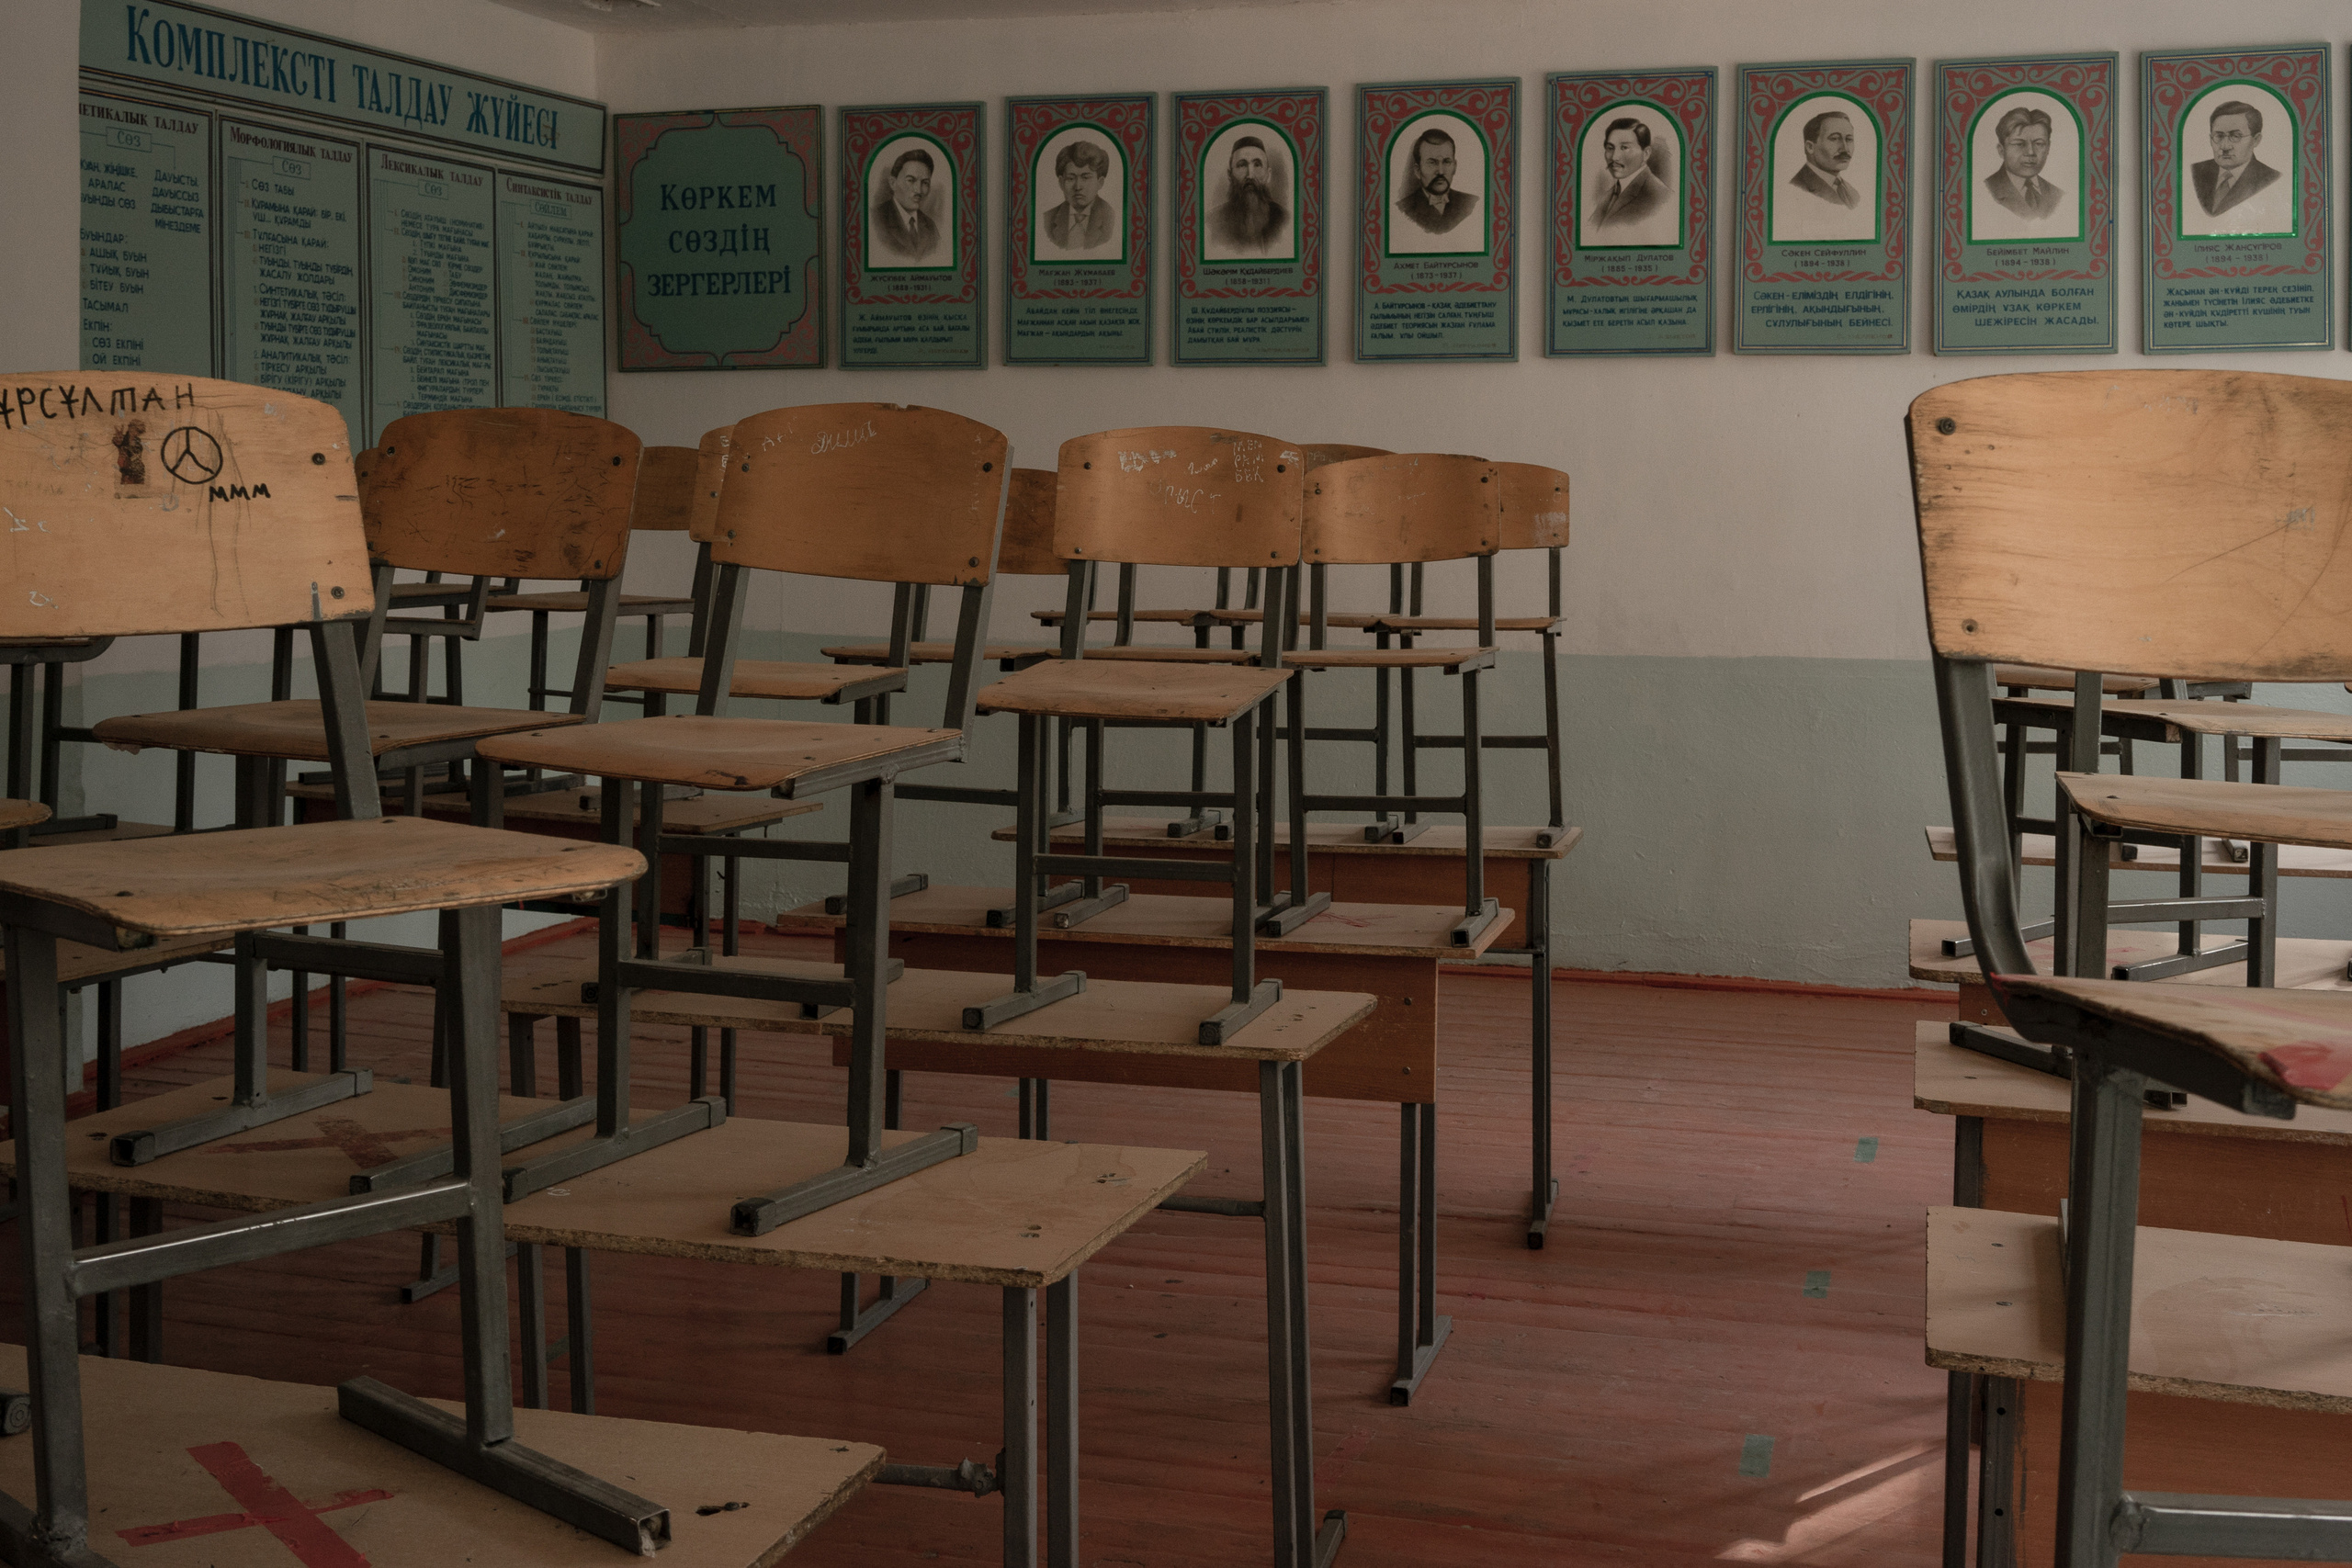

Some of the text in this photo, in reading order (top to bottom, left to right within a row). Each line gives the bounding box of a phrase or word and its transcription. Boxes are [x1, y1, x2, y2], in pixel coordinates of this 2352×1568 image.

[126, 4, 560, 150] КОМПЛЕКСТІ ТАЛДАУ ЖҮЙЕСІ
[153, 116, 198, 134] ТАЛДАУ
[117, 130, 141, 147] СӨЗ
[320, 148, 353, 163] ТАЛДАУ
[282, 160, 302, 175] СӨЗ
[88, 178, 126, 192] АРАЛАС
[449, 171, 483, 186] ТАЛДАУ
[152, 186, 199, 202] ДАУЫССЫЗ
[252, 178, 295, 196] СӨЗ ТАБЫ
[424, 183, 443, 197] СӨЗ
[118, 197, 136, 209] СӨЗ
[565, 192, 593, 205] ТАЛДАУ
[660, 184, 777, 211] КӨРКЕМ
[150, 203, 204, 219] ДЫБЫСТАРҒА
[154, 218, 201, 233] МІНЕЗДЕМЕ
[668, 223, 771, 257] СӨЗДІҢ
[89, 247, 147, 263] АШЫҚ БУЫН
[258, 243, 286, 256] НЕГІЗГІ
[1781, 249, 1867, 257] СӘКЕН СЕЙФУЛЛИН
[1986, 246, 2070, 256] БЕЙІМБЕТ МАЙЛИН
[2195, 243, 2283, 253] ІЛИЯС ЖАНСҮГІРОВ
[1585, 254, 1674, 263] МІРЖАҚЫП ДУЛАТОВ
[125, 267, 149, 278] БУЫН
[1394, 262, 1419, 270] АХМЕТ
[259, 267, 335, 286] ЖАСАЛУ ЖОЛДАРЫ
[647, 265, 792, 297] ЗЕРГЕРЛЕРІ
[910, 274, 953, 282] АЙМАУЫТОВ
[90, 277, 143, 294] БІТЕУ БУЫН
[2166, 288, 2206, 296] ЖАСЫНАН
[2253, 285, 2278, 294] ТЕРЕҢ
[1754, 290, 1785, 300] СӘКЕН
[1957, 288, 2095, 299] ҚАЗАҚ АУЛЫНДА БОЛҒАН
[2269, 295, 2314, 304] ӘДЕБИЕТКЕ
[82, 298, 129, 312] ТАСЫМАЛ
[1026, 306, 1057, 315] АБАЙДАН
[1061, 306, 1080, 314] КЕЙІН
[1084, 305, 1096, 314] ТІЛ
[1686, 306, 1697, 314] ДА
[1951, 301, 2081, 313] ӨМІРДІҢ ҰЗАҚ КӨРКЕМ
[1974, 316, 2099, 327] ШЕЖІРЕСІН ЖАСАДЫ.
[92, 337, 144, 350] СӨЗ ЕКПІНІ
[93, 353, 141, 367] ОЙ ЕКПІНІ
[261, 361, 327, 375] ТІРКЕСУ АРҚЫЛЫ
